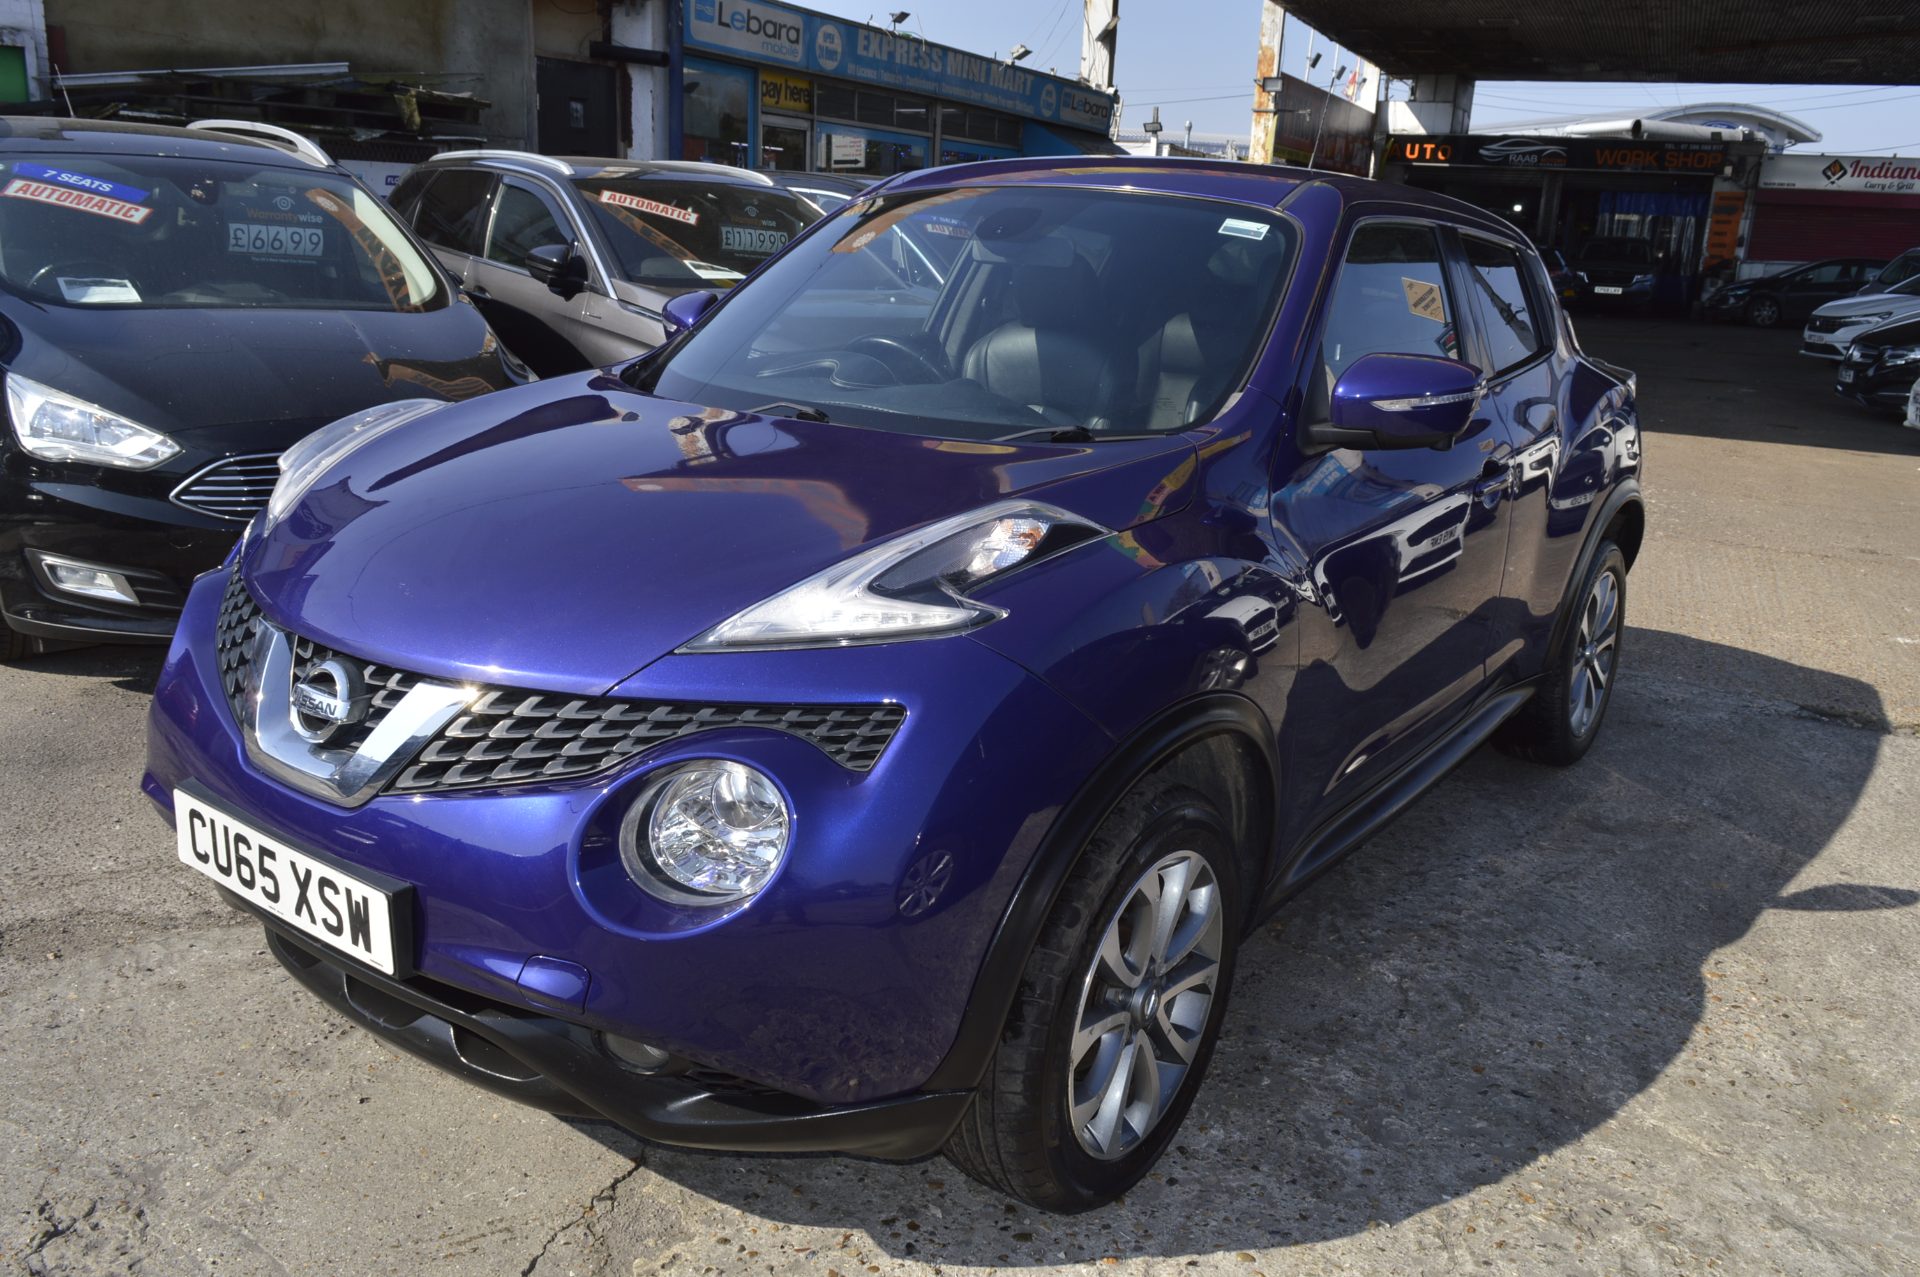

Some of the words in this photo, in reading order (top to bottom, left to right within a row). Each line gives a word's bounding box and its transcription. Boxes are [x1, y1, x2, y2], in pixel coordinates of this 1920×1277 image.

[718, 2, 800, 45] Lebara
[762, 40, 799, 58] mobile
[857, 28, 942, 73] EXPRESS
[947, 50, 987, 83] MINI
[990, 62, 1035, 96] MART
[762, 80, 782, 104] pay
[784, 77, 810, 103] here
[1071, 93, 1108, 118] Lebara
[1509, 153, 1538, 162] RAAB
[1596, 149, 1658, 166] WORK
[1665, 151, 1725, 168] SHOP
[1850, 159, 1920, 179] Indian
[43, 170, 57, 178] 7
[57, 173, 113, 192] SEATS
[1864, 181, 1886, 190] Curry
[1896, 182, 1915, 191] Grill
[14, 182, 140, 219] AUTOMATIC
[607, 193, 692, 221] AUTOMATIC
[232, 227, 321, 252] £6699
[725, 230, 787, 250] £11999
[297, 690, 337, 716] SSAN
[189, 808, 281, 904] CU65
[289, 859, 372, 954] XSW
